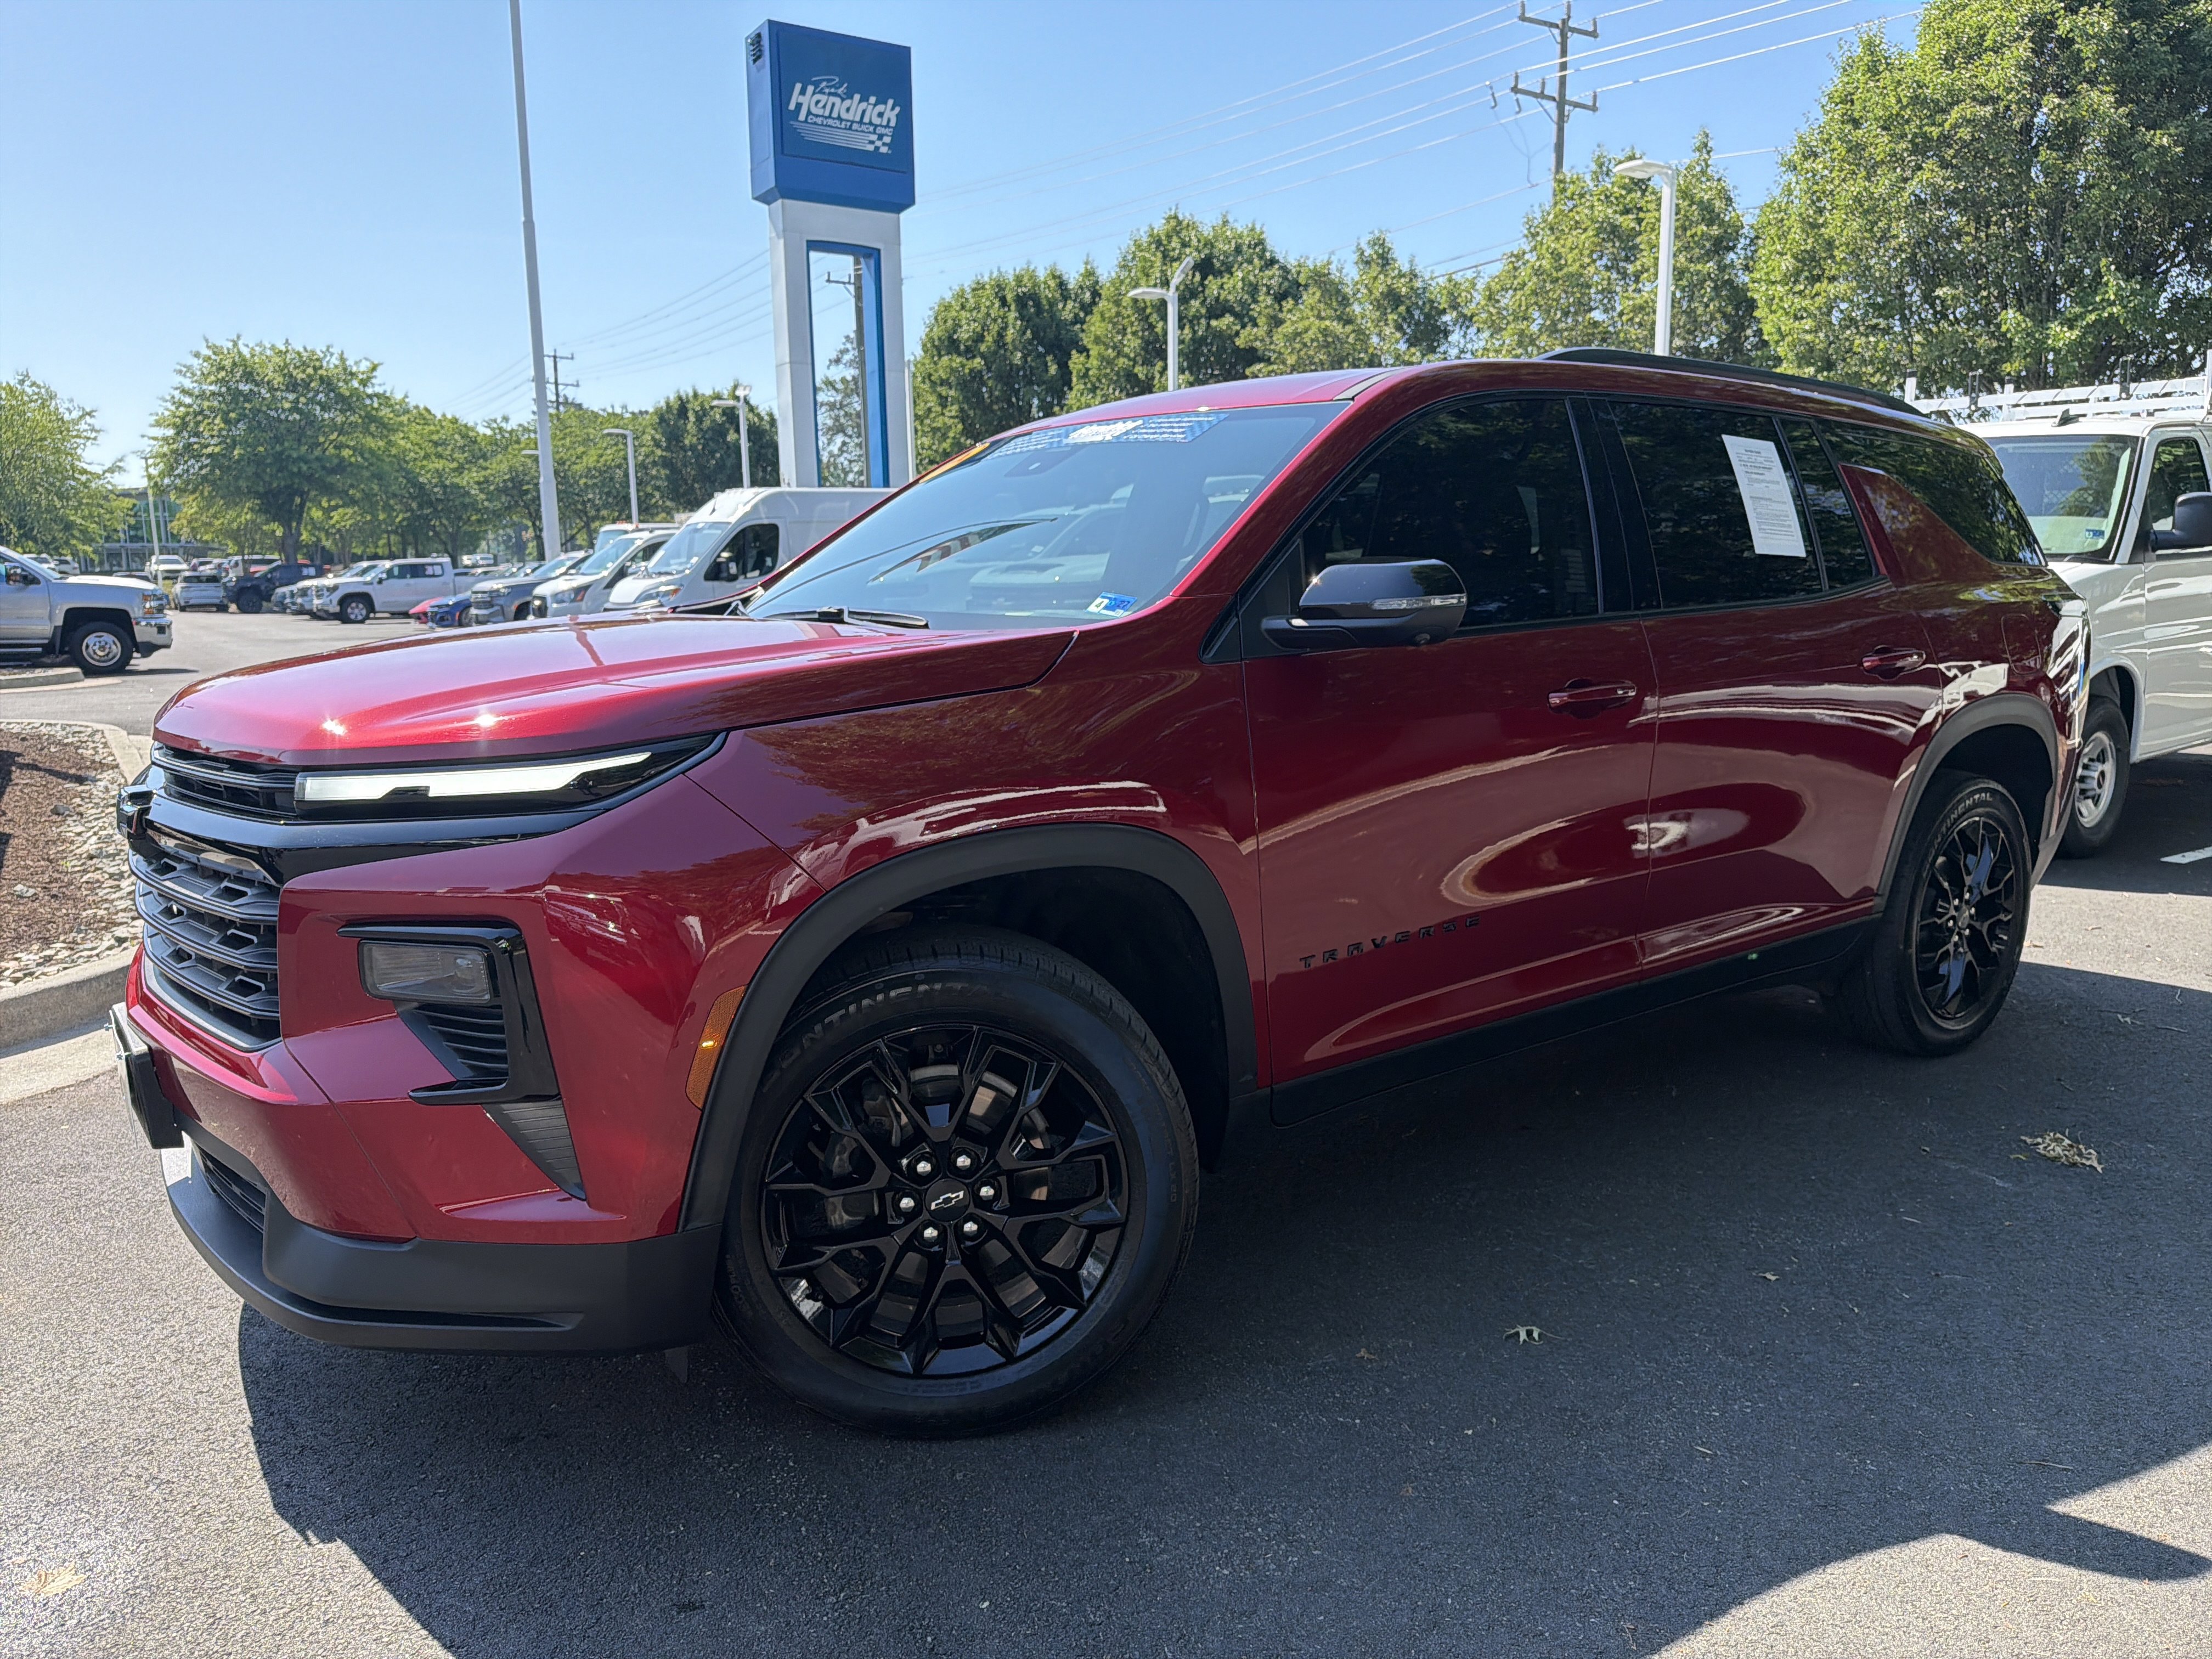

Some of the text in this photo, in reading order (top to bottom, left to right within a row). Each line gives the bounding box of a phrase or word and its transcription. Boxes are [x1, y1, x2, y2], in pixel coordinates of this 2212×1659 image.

[788, 82, 901, 127] Hendrick
[807, 115, 894, 136] CHEVROLET BUICK GMC
[1300, 915, 1480, 969] TRAVERSE
[761, 983, 991, 1093] ONTINENTA
